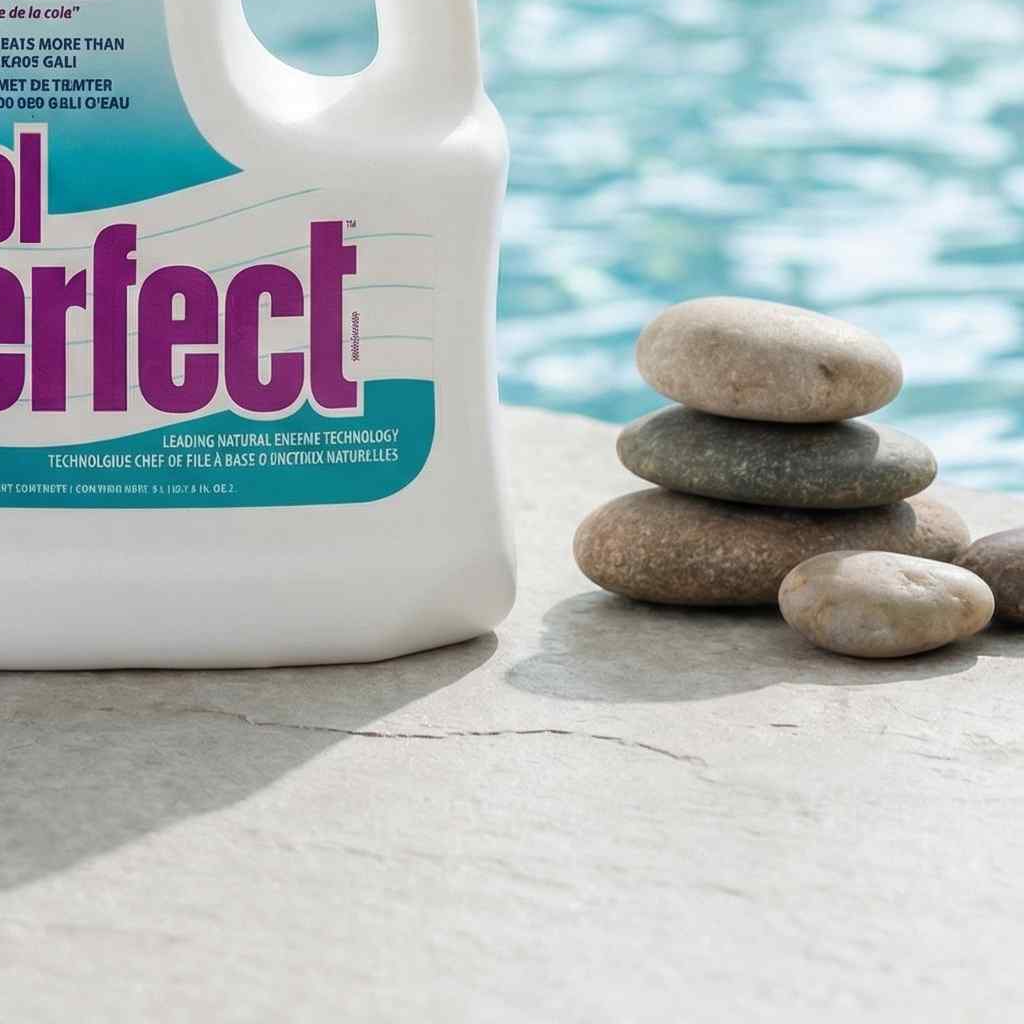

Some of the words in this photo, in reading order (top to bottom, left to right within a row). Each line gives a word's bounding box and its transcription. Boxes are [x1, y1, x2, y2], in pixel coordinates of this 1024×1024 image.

[9, 6, 25, 18] de
[39, 38, 80, 51] MORE
[84, 38, 125, 51] THAN
[30, 79, 50, 92] DE
[163, 435, 215, 448] LEADING
[218, 433, 271, 447] NATURAL
[323, 428, 399, 445] TECHNOLOGY
[134, 454, 164, 467] CHEF
[186, 453, 211, 467] FILE
